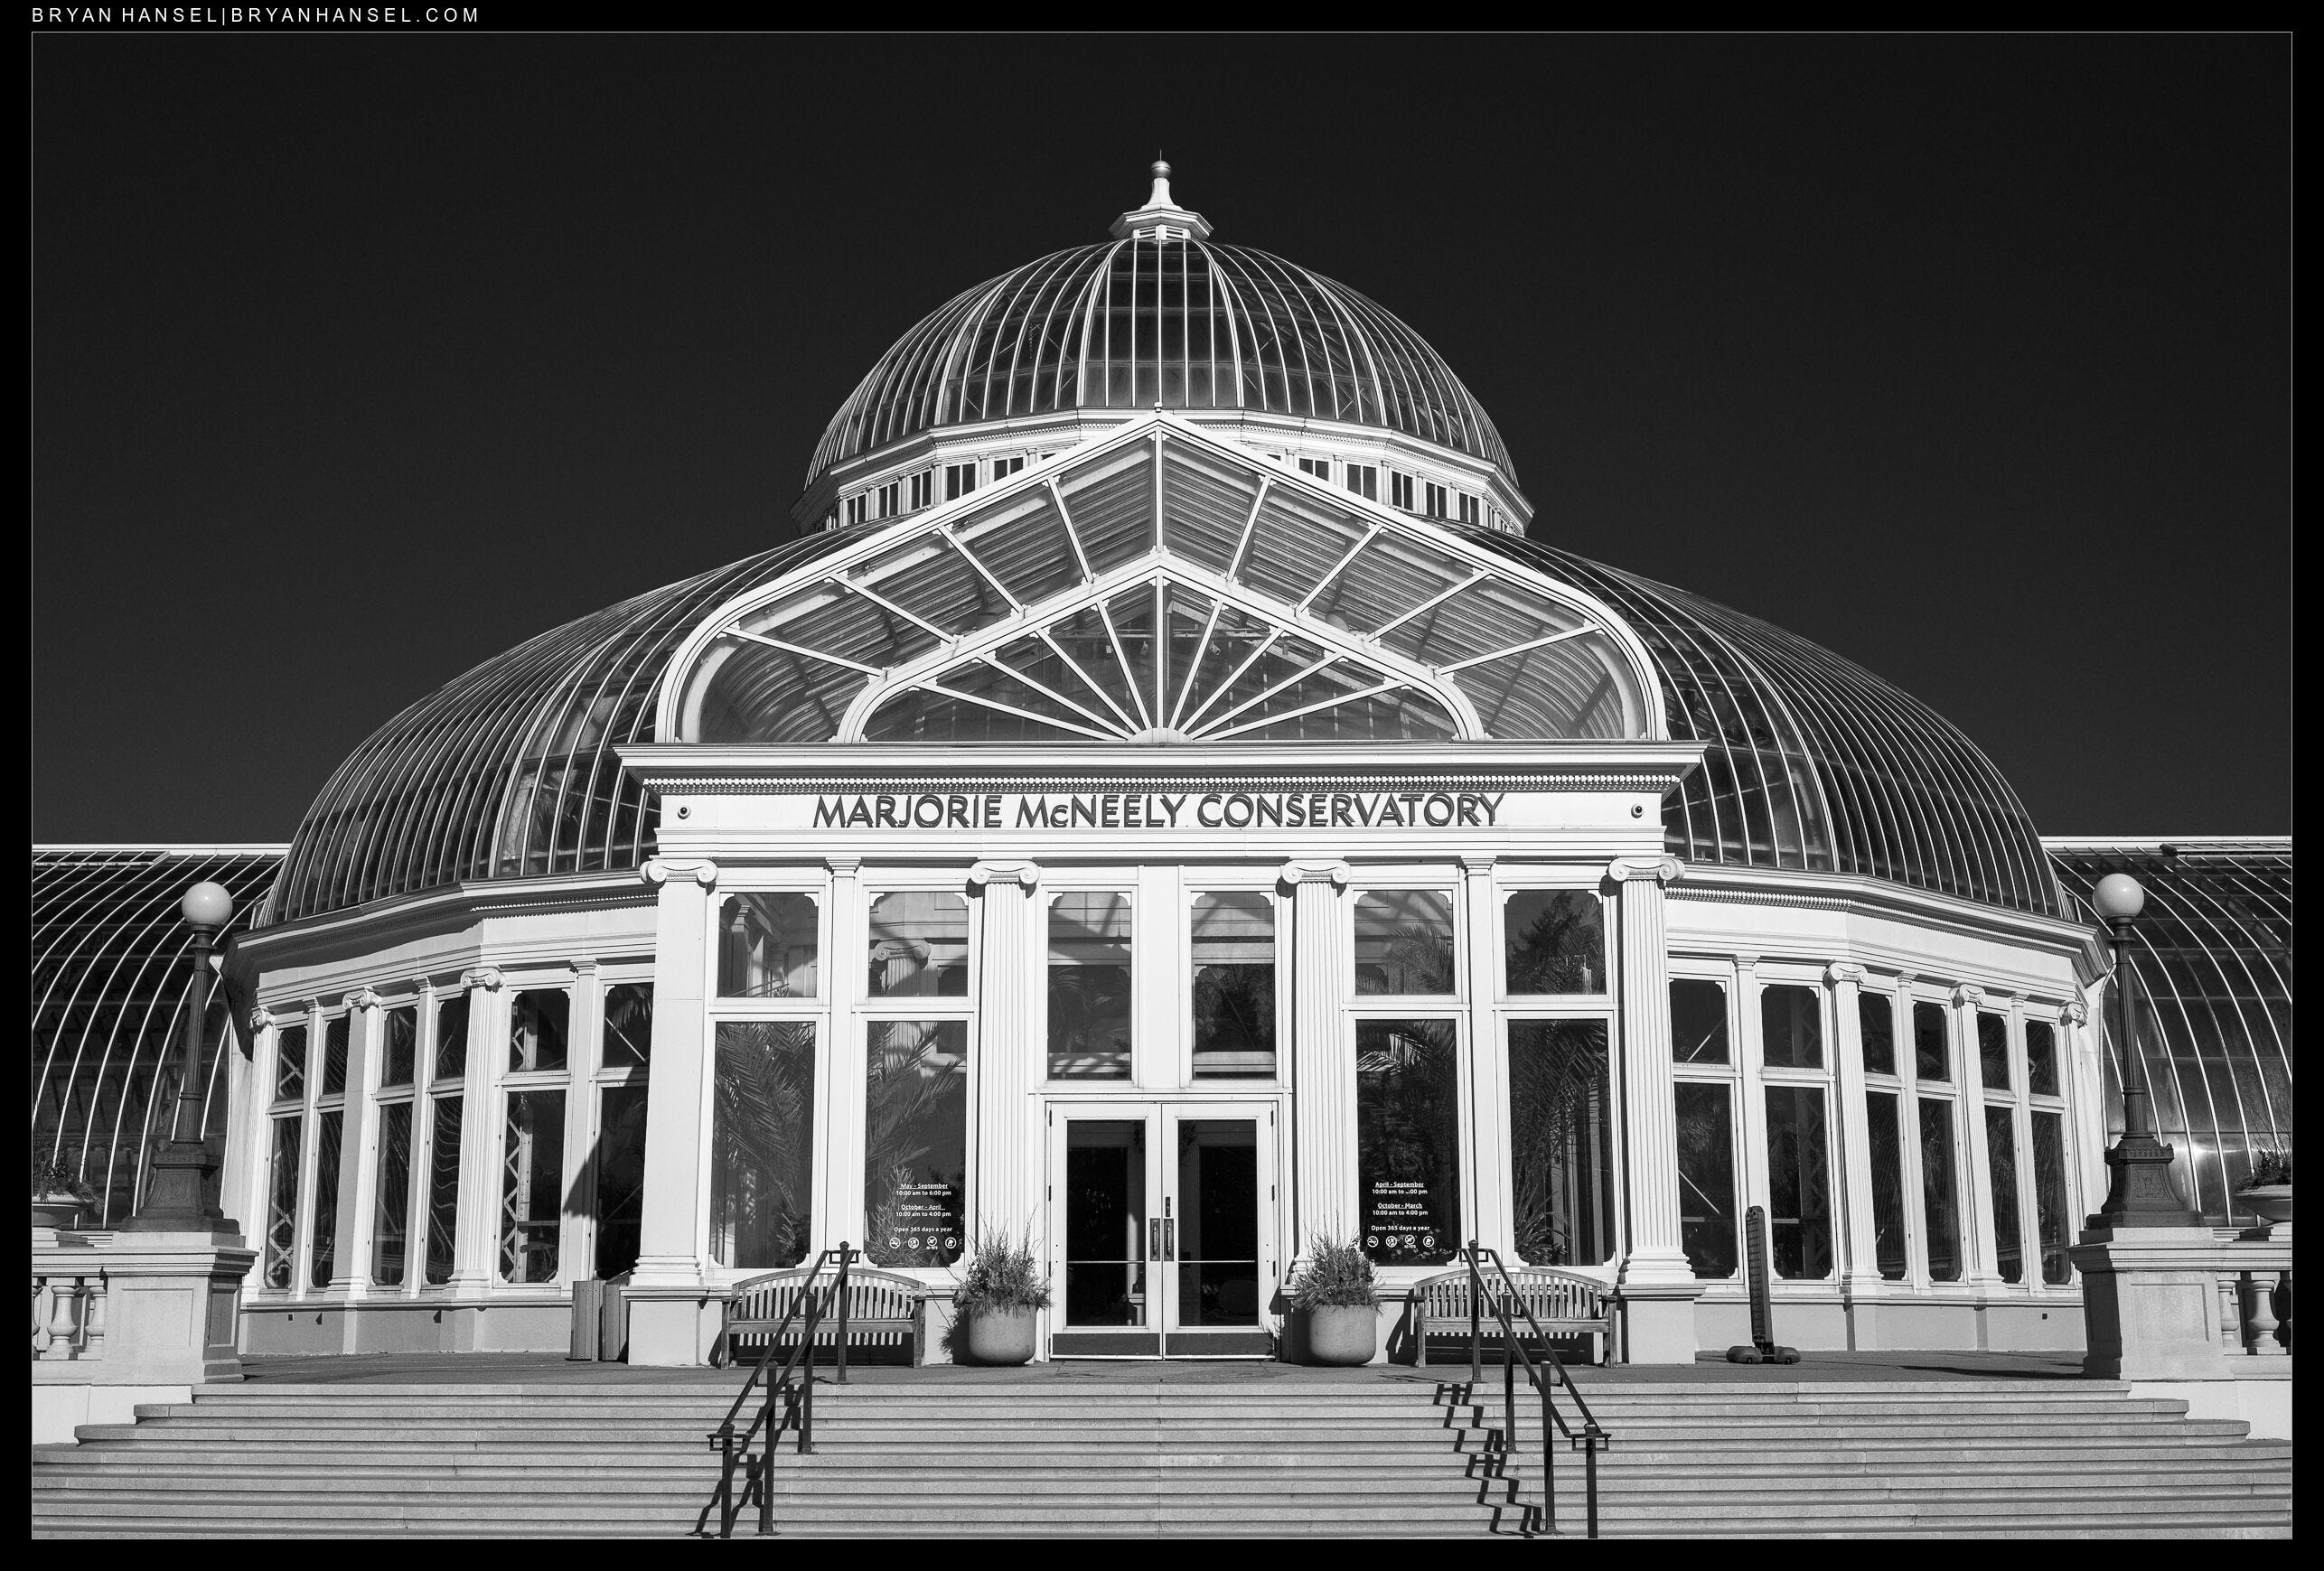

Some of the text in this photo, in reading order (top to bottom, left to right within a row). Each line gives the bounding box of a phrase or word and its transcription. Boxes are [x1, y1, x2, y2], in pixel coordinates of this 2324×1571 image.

[813, 793, 1505, 828] MARJORIE McNEELY CONSERVATORY
